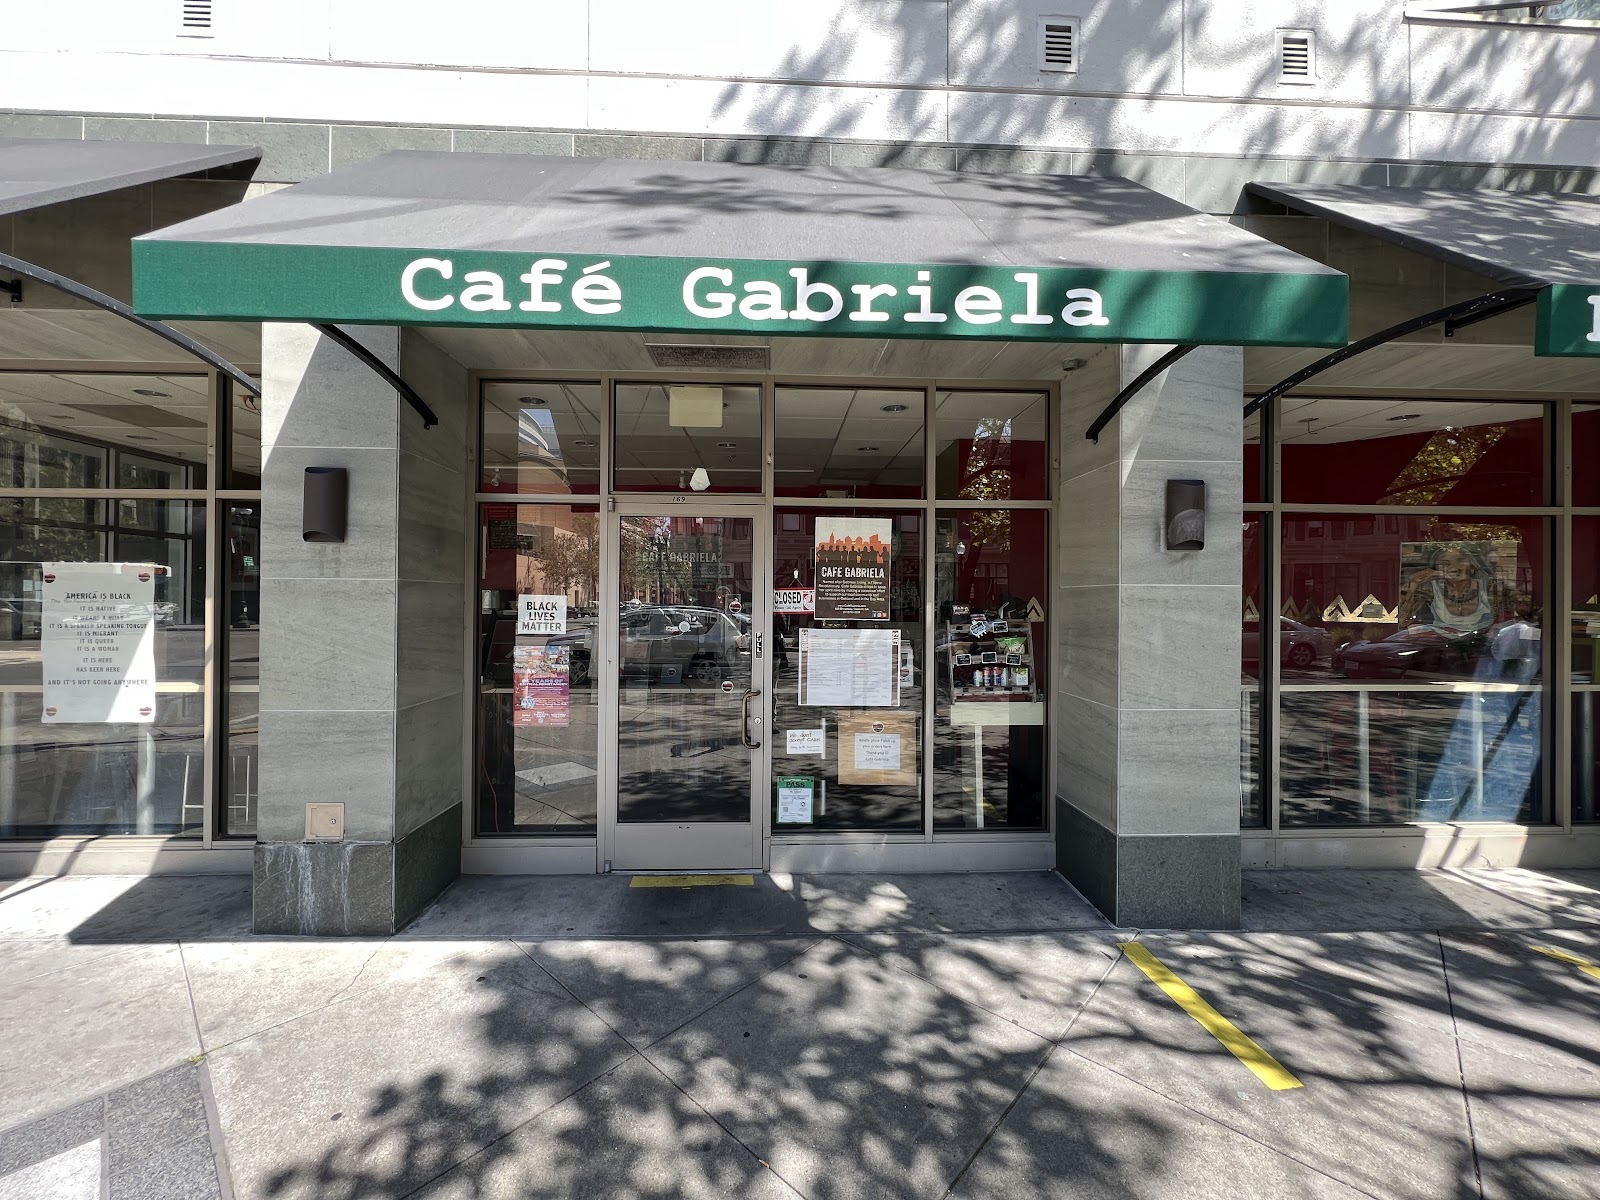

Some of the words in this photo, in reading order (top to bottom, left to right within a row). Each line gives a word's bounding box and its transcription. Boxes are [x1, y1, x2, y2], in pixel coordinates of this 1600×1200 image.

[400, 257, 622, 315] Café
[682, 266, 1110, 327] Gabriela
[821, 566, 843, 578] CAFE
[844, 567, 885, 578] GABRIELA
[775, 592, 802, 604] CLOSED
[526, 601, 558, 611] BLACK
[528, 611, 556, 621] LIVES
[522, 621, 562, 632] MATTER
